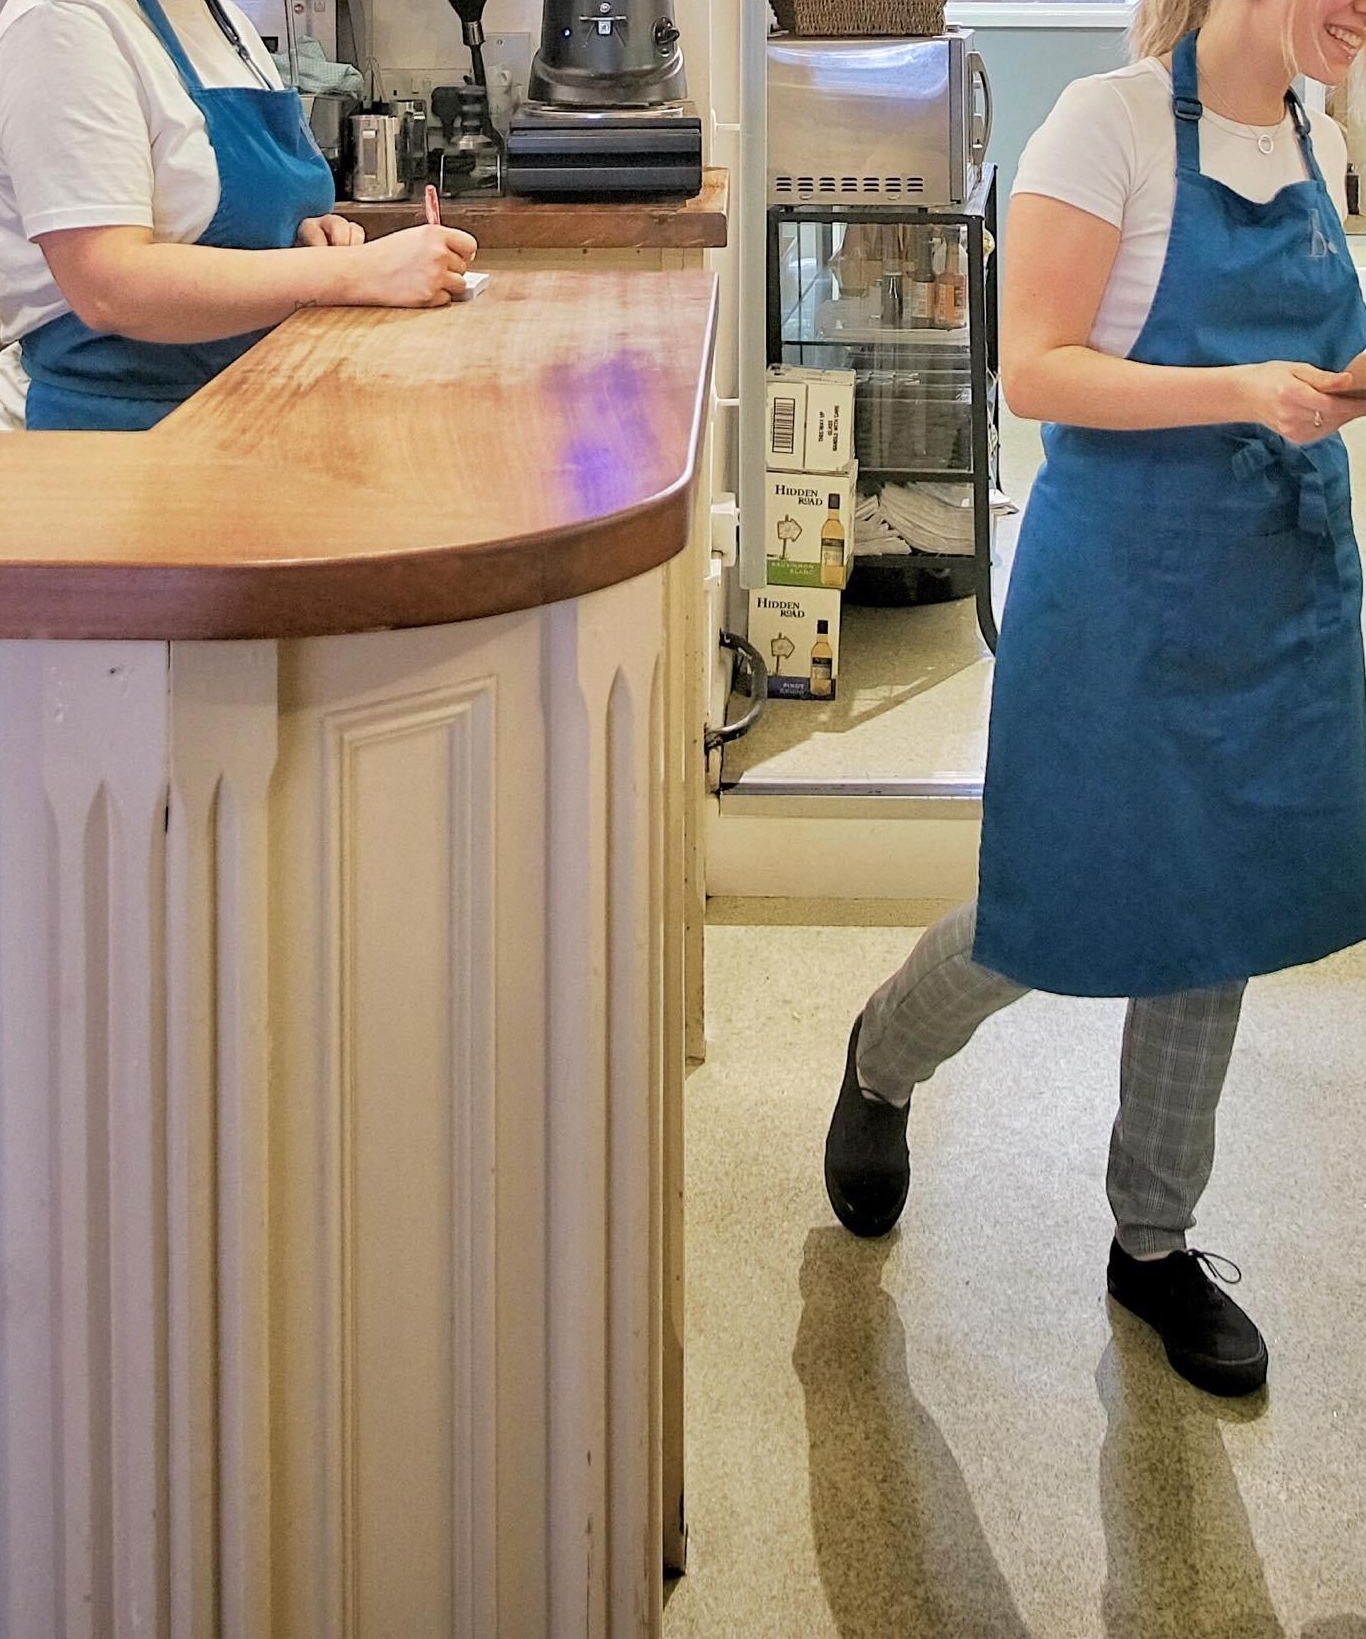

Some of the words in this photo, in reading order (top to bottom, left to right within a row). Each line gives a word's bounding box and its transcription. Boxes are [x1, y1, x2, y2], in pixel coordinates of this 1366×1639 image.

[774, 483, 819, 498] HIDDEN
[797, 495, 824, 507] ROAD
[756, 596, 801, 611] HIDDEN
[779, 607, 806, 619] ROAD
